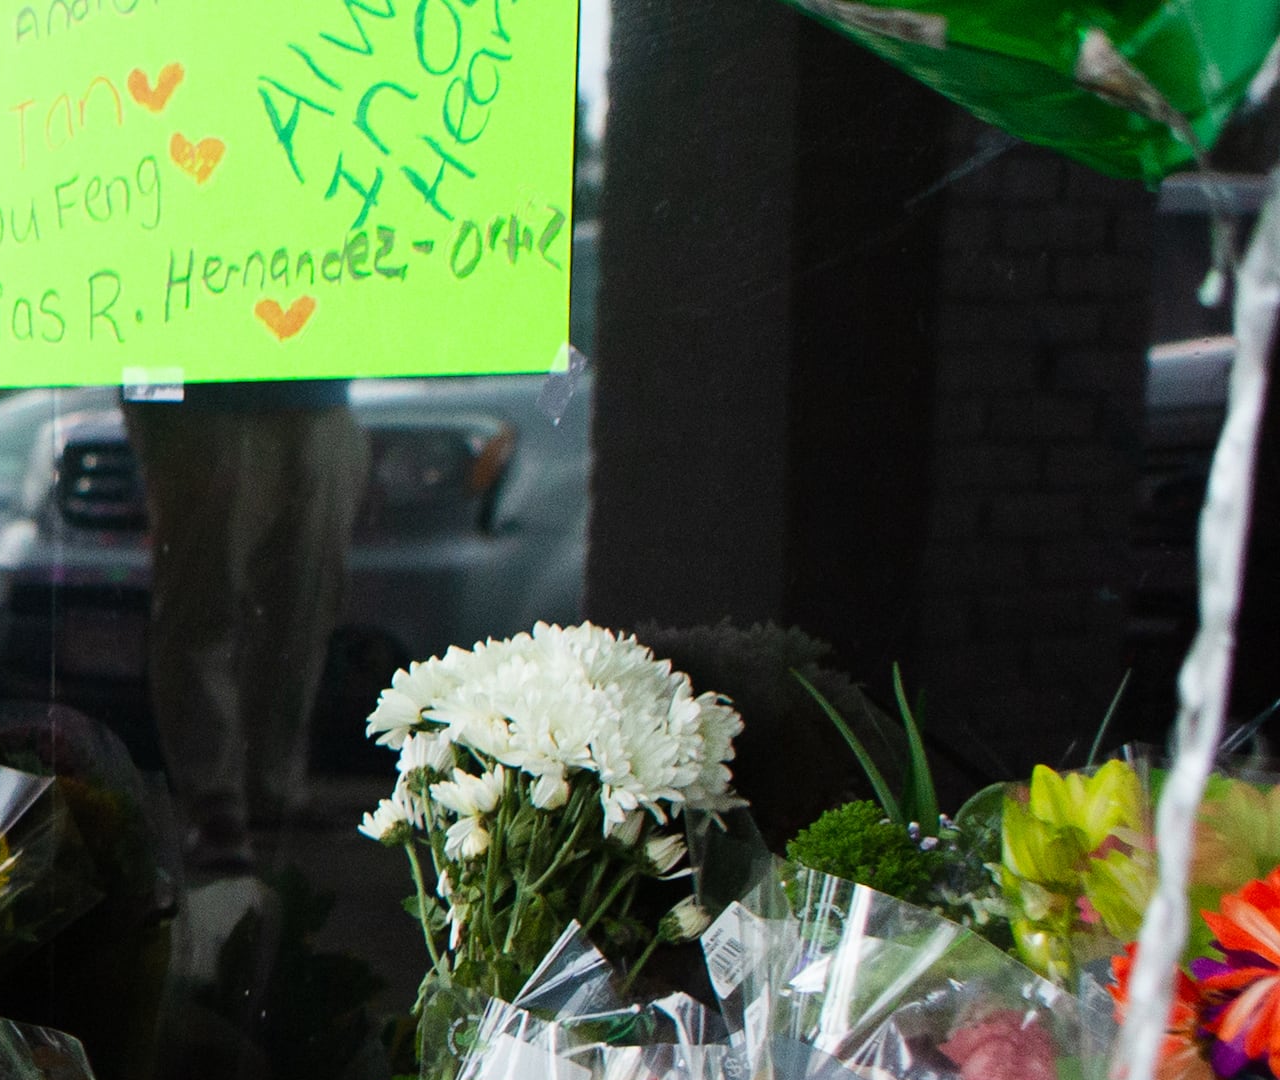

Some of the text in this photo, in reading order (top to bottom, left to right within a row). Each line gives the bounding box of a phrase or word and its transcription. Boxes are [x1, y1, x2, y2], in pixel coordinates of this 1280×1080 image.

[9, 75, 124, 172] Tan
[54, 146, 162, 231] Feng
[87, 268, 144, 344] R.
